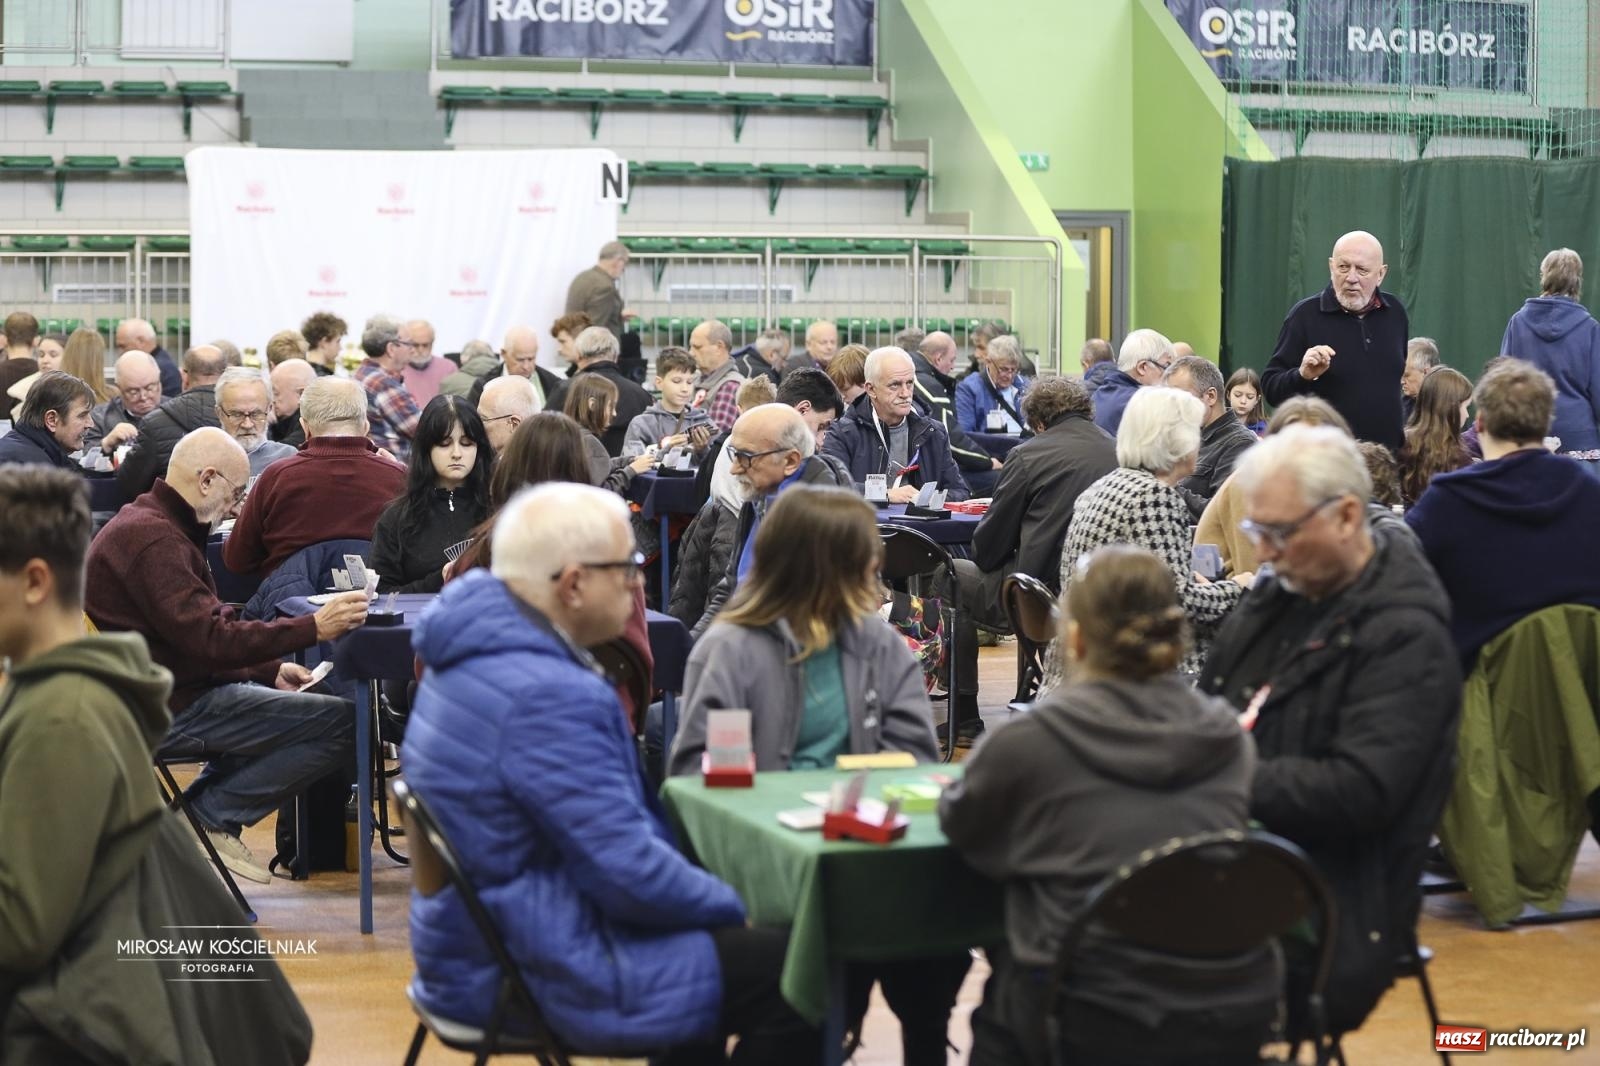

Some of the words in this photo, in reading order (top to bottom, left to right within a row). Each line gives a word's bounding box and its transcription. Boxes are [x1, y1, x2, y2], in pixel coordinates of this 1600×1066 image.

[724, 0, 834, 29] OSiR
[1199, 7, 1297, 47] OSiR
[1347, 22, 1496, 58] RACIBÓRZ
[602, 163, 622, 198] N
